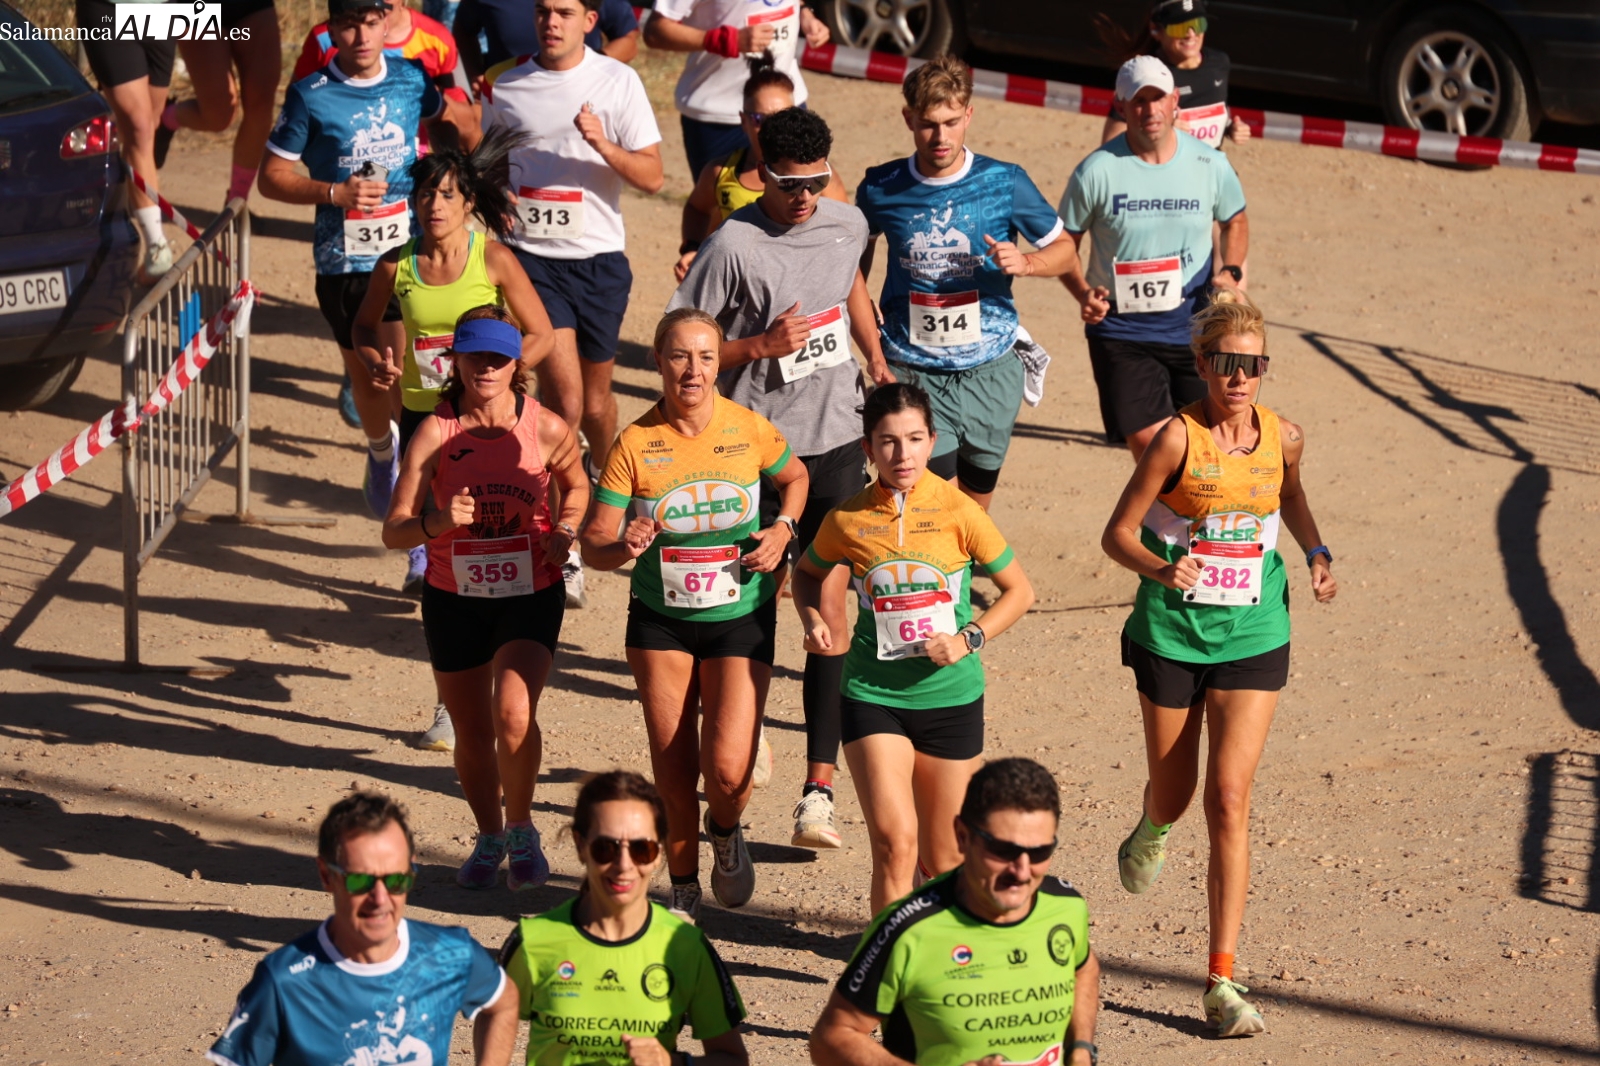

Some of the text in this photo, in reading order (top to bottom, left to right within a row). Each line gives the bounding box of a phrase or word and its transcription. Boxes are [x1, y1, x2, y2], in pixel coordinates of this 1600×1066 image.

[357, 143, 404, 158] IX Carrera
[1112, 193, 1200, 216] FERREIRA
[527, 207, 570, 226] 313
[358, 223, 400, 242] 312
[913, 250, 969, 261] IX Carrera
[23, 276, 61, 305] CRC
[1129, 280, 1170, 299] 167
[922, 313, 968, 332] 314
[795, 333, 837, 364] 256
[655, 470, 747, 498] CLUB DEPORTIVO
[469, 483, 537, 507] LA ESCAPADA
[481, 501, 505, 515] RUN
[662, 496, 744, 521] ALCER
[481, 515, 506, 526] CLUB
[1195, 526, 1258, 542] ALCER
[886, 550, 948, 570] DEPORTIVO
[467, 561, 518, 584] 359
[684, 571, 718, 593] 67
[1202, 565, 1251, 589] 382
[899, 616, 934, 642] 65
[848, 888, 941, 993] CORRECAMINOS
[943, 978, 1075, 1008] CORRECAMINO
[545, 1015, 673, 1034] CORRECAMINOS
[557, 1034, 623, 1048] CARBAJ
[988, 1033, 1056, 1048] SALAMANCA
[570, 1050, 630, 1060] SALAMAN
